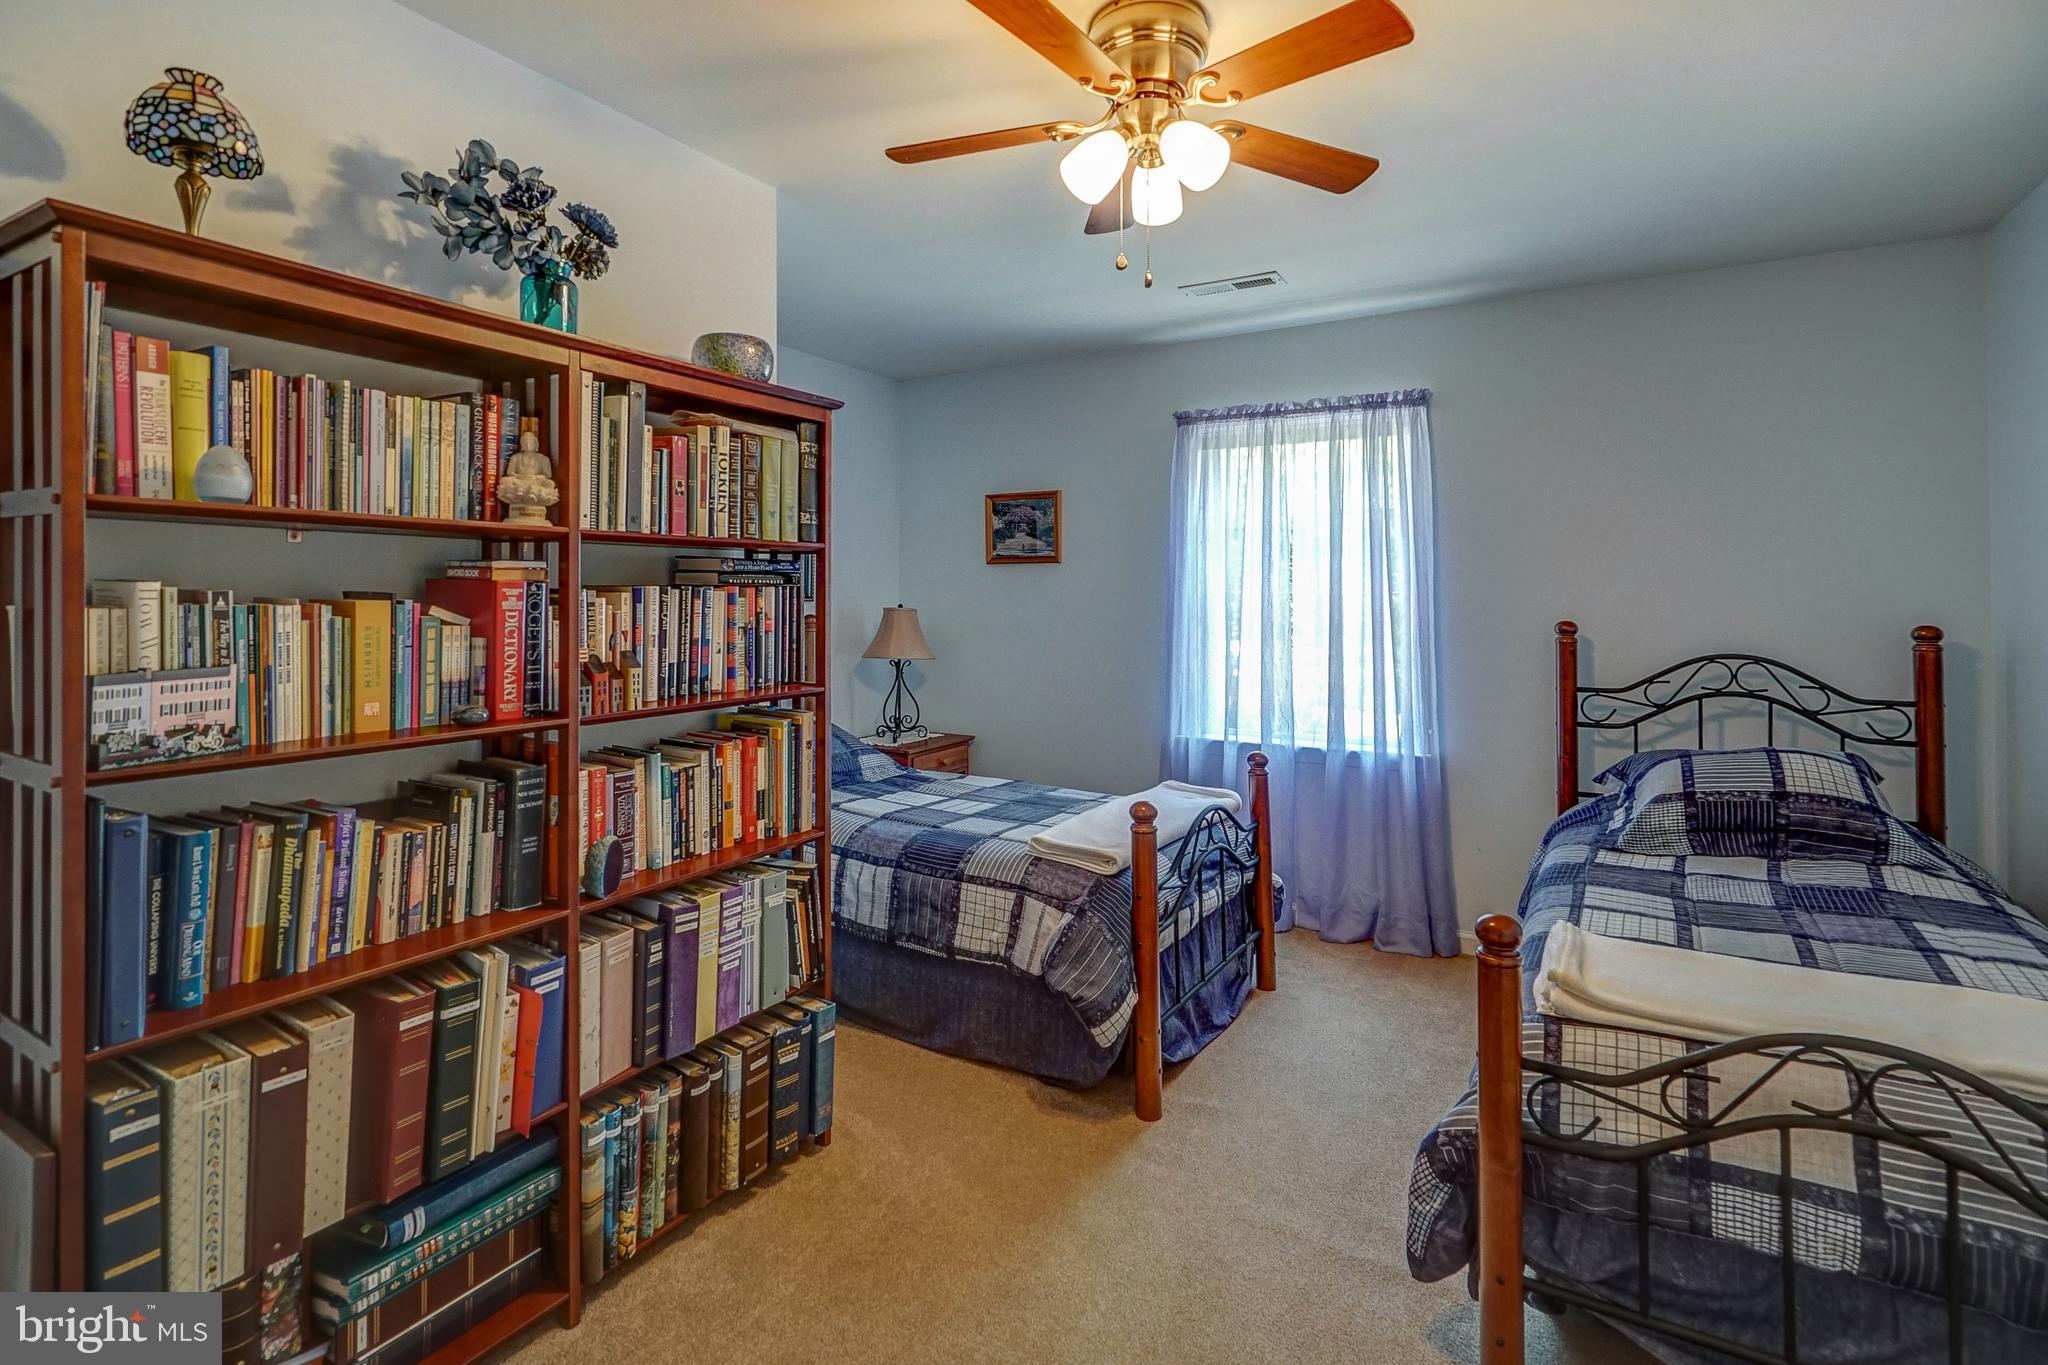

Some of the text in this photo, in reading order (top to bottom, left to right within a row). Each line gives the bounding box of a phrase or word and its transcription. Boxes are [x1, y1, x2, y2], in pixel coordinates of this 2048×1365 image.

[140, 386, 154, 445] REVOLUTION
[473, 408, 483, 469] GLENN BECK
[487, 412, 498, 475] RUSH LIMBAUGH
[717, 452, 728, 514] TOLKIEN
[139, 588, 160, 629] How
[219, 620, 230, 634] The
[527, 591, 543, 660] ROGET'S
[217, 633, 230, 650] Way
[363, 626, 371, 688] BUDDHISM
[503, 611, 519, 703] DICTIONARY
[527, 665, 540, 674] II
[518, 777, 543, 785] WEBSTER'S
[617, 794, 626, 836] VITAMINS
[293, 852, 303, 869] The
[336, 812, 352, 898] Perfect Brilliant Stillness
[433, 831, 442, 865] Psychotherapy
[447, 823, 458, 887] CONTEMPLATIVE SCIENCE
[277, 837, 299, 928] Dhammapada
[148, 878, 162, 975] THE COLLAPSING UNIVERSE
[181, 924, 194, 978] DREAMING MIND
